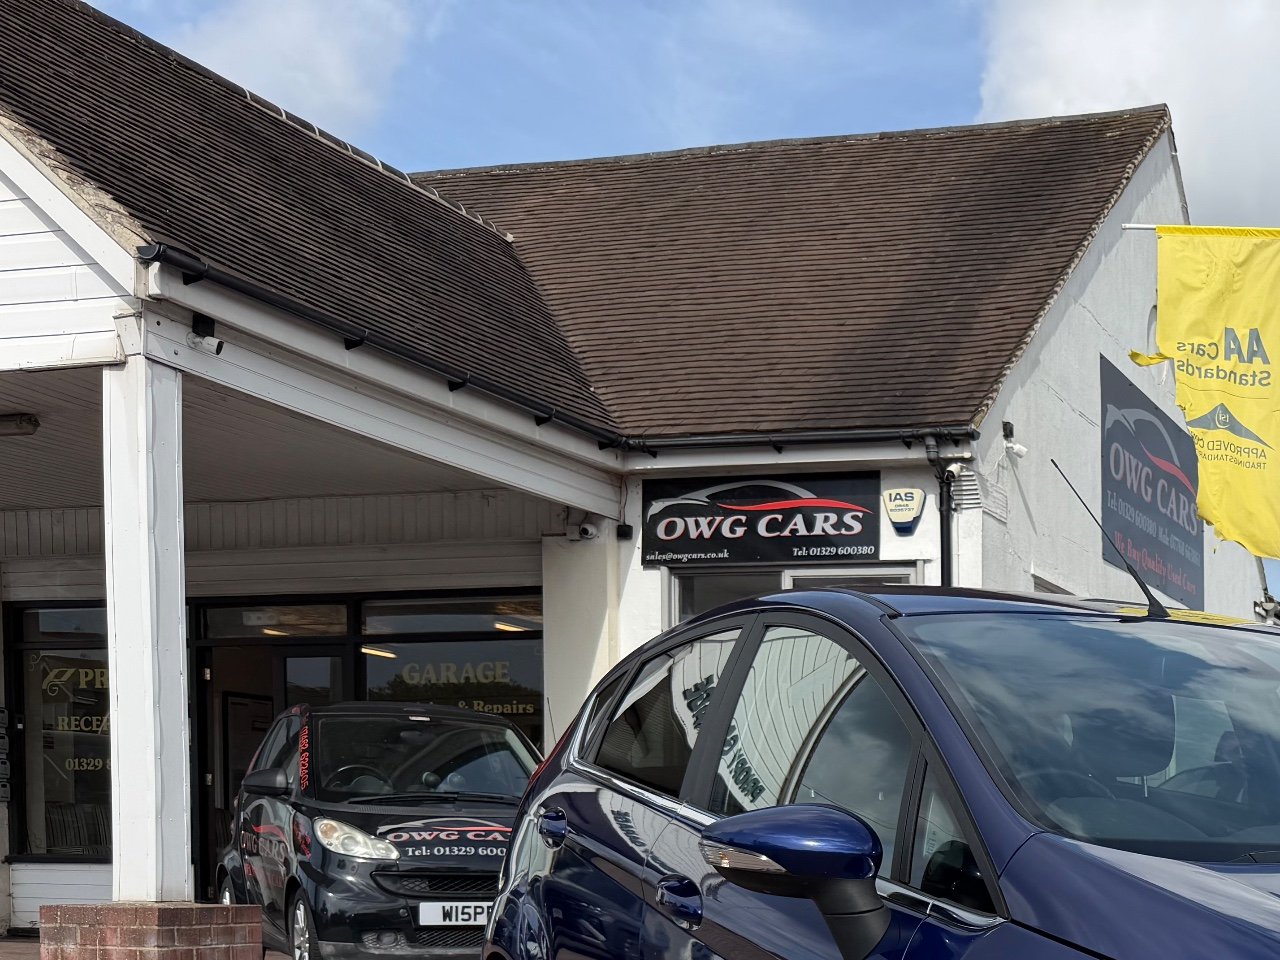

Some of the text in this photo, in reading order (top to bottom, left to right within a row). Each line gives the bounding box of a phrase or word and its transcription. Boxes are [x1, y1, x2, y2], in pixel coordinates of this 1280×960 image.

[1109, 442, 1199, 536] OWG CARS
[889, 491, 915, 503] IAS
[656, 511, 864, 541] OWG CARS
[645, 549, 730, 563] sales@owgcars.co.uk
[792, 545, 875, 557] Tel: 01329 600380
[402, 661, 511, 684] GARAGE
[473, 700, 534, 714] Repairs
[65, 758, 103, 771] 01329
[386, 831, 460, 842] OWG
[405, 847, 431, 856] Tel:
[434, 846, 475, 856] 01329
